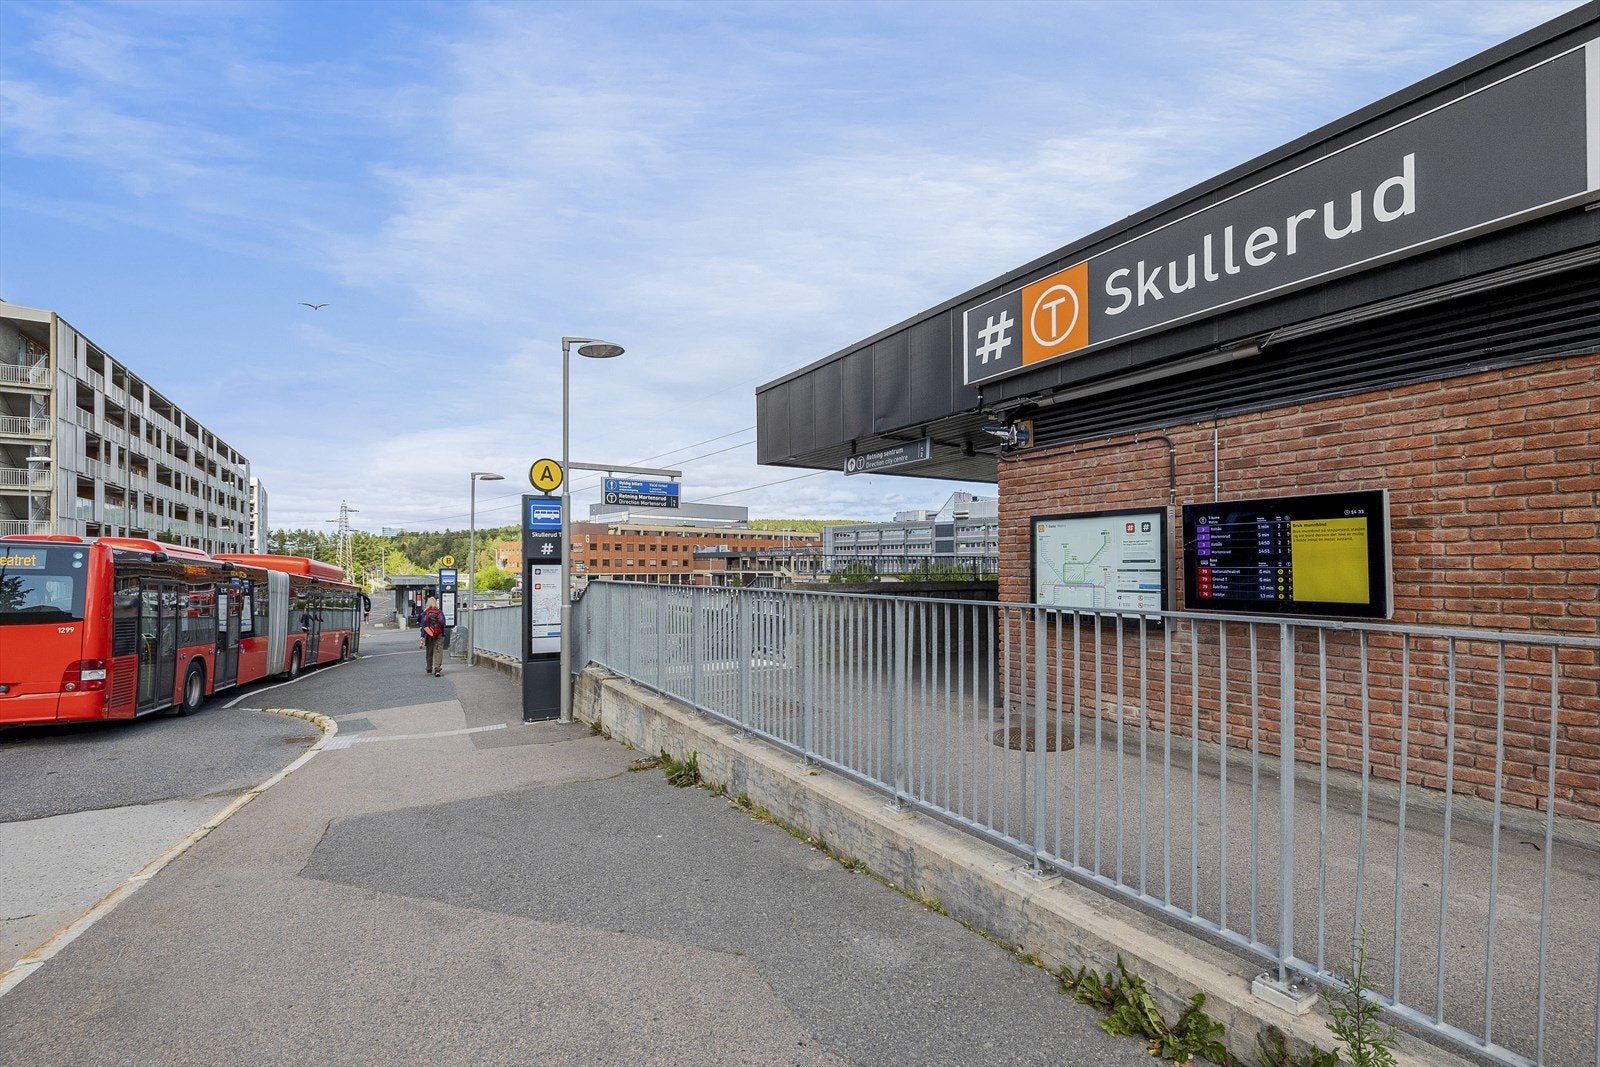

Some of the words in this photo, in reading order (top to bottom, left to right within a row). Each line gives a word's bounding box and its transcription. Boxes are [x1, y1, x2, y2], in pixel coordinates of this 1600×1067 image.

[1104, 152, 1416, 316] Skullerud
[866, 452, 883, 460] Retning
[884, 448, 904, 457] sentrum
[865, 459, 884, 468] Direction
[885, 457, 893, 465] city
[894, 455, 908, 463] centre
[540, 465, 554, 482] A
[0, 554, 37, 567] eatret
[57, 626, 75, 634] 1299
